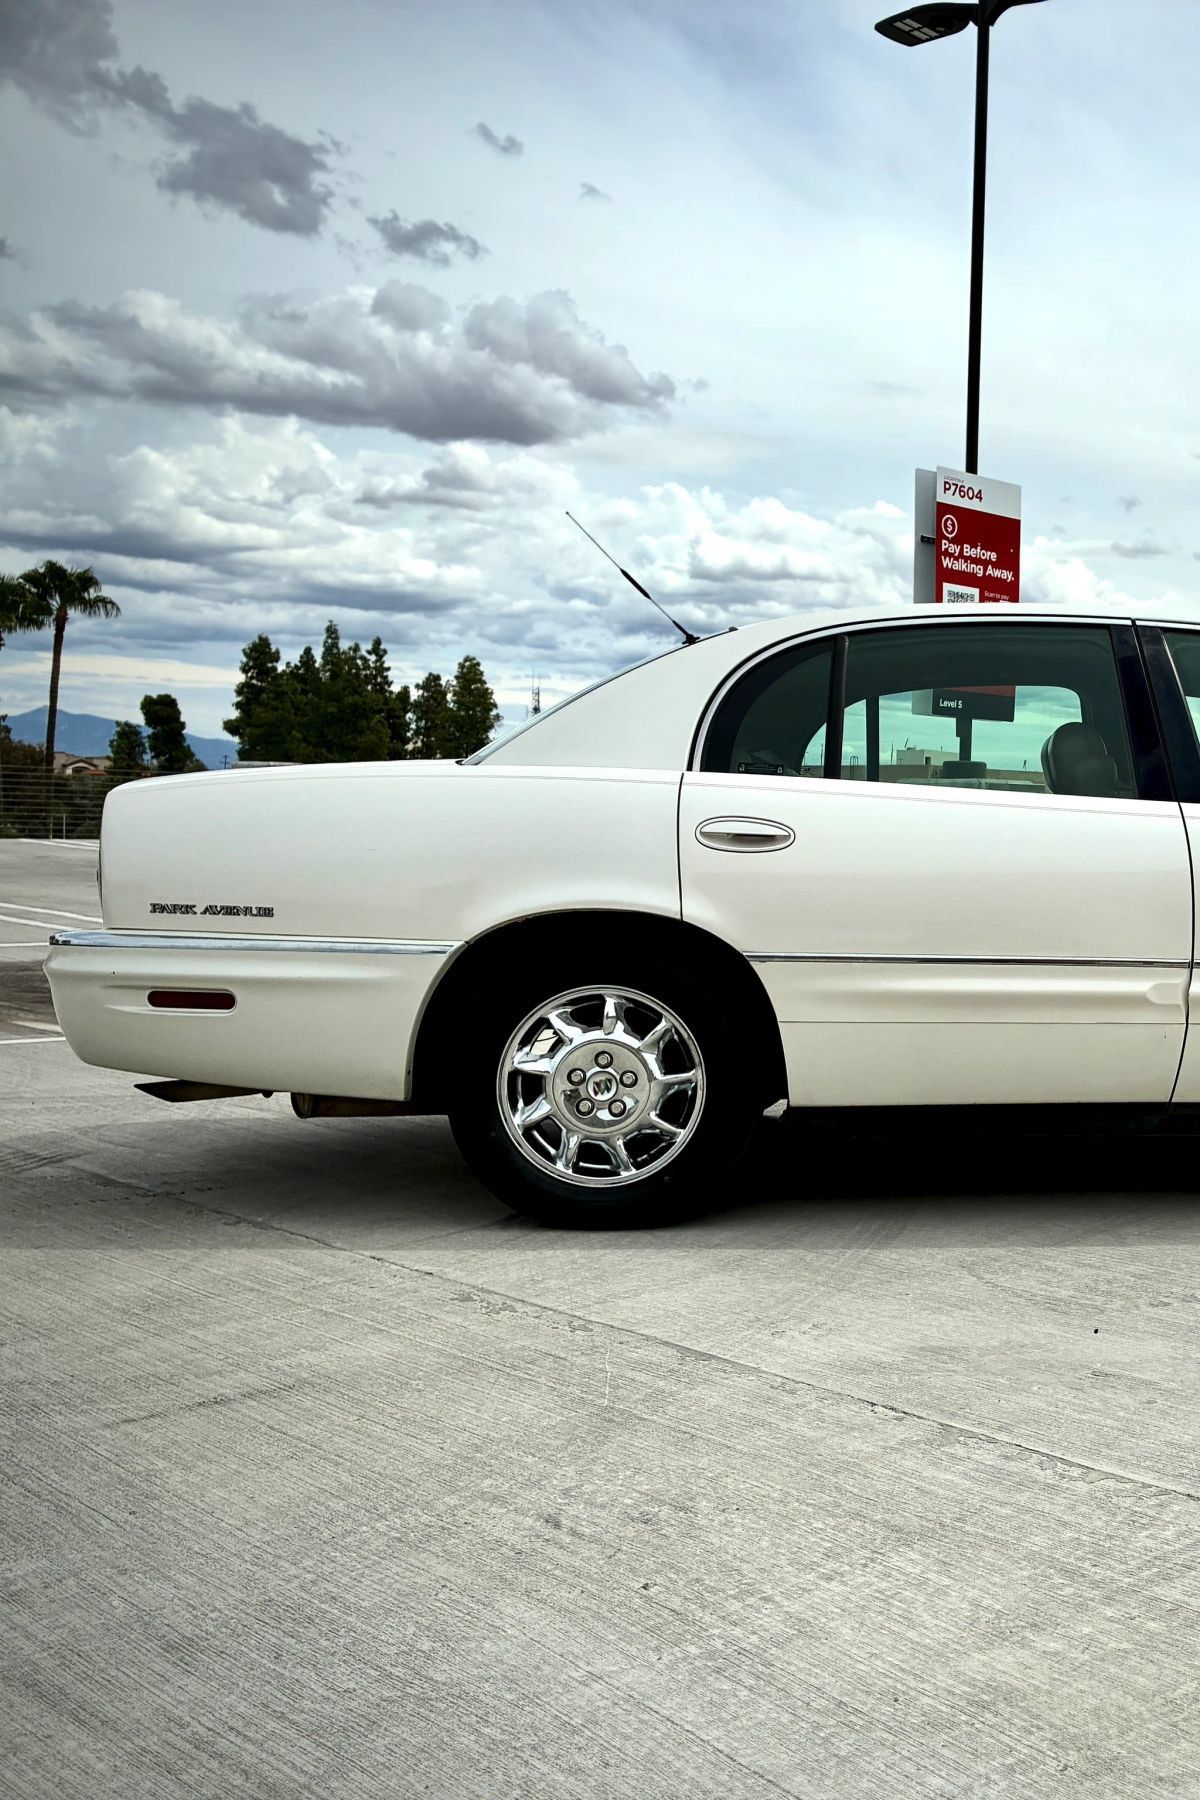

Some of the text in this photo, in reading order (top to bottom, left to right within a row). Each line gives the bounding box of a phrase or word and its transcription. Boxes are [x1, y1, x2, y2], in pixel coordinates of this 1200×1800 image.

[943, 480, 983, 502] P7604
[941, 540, 997, 561] Pay Before
[941, 555, 1014, 582] Walking Away.
[984, 590, 995, 598] Scan
[939, 698, 963, 709] Level 5
[149, 903, 274, 918] PARK AVENUE
